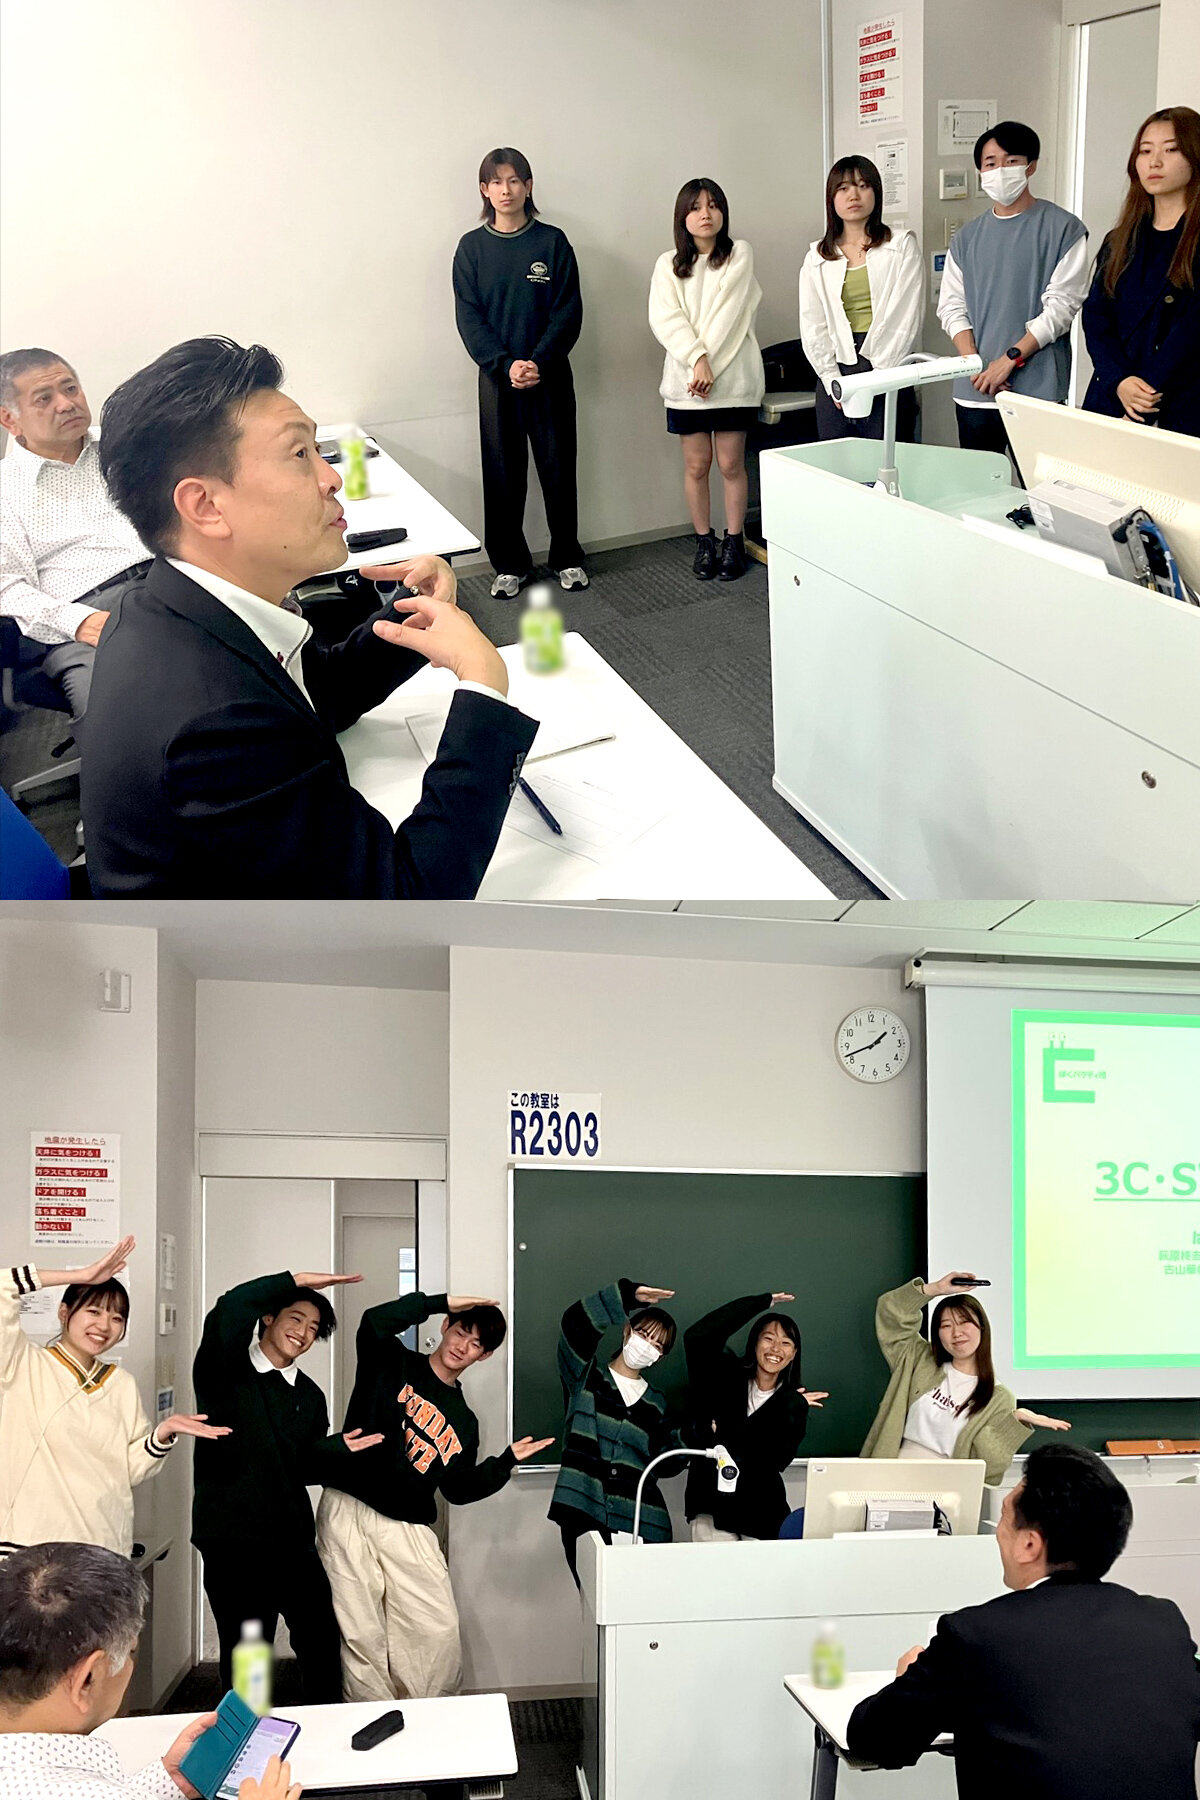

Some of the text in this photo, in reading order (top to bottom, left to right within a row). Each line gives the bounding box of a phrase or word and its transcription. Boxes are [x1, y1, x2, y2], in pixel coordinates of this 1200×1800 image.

[868, 1014, 875, 1023] 12
[846, 1028, 854, 1037] 10
[891, 1026, 897, 1035] 2
[844, 1042, 850, 1050] 9
[897, 1039, 902, 1048] 3
[849, 1055, 855, 1064] 8
[860, 1064, 866, 1073] 7
[872, 1067, 878, 1076] 6
[885, 1063, 891, 1072] 5
[510, 1092, 560, 1109] この教室は
[511, 1110, 599, 1157] R2303
[36, 1168, 107, 1177] ガラスに気をつける！
